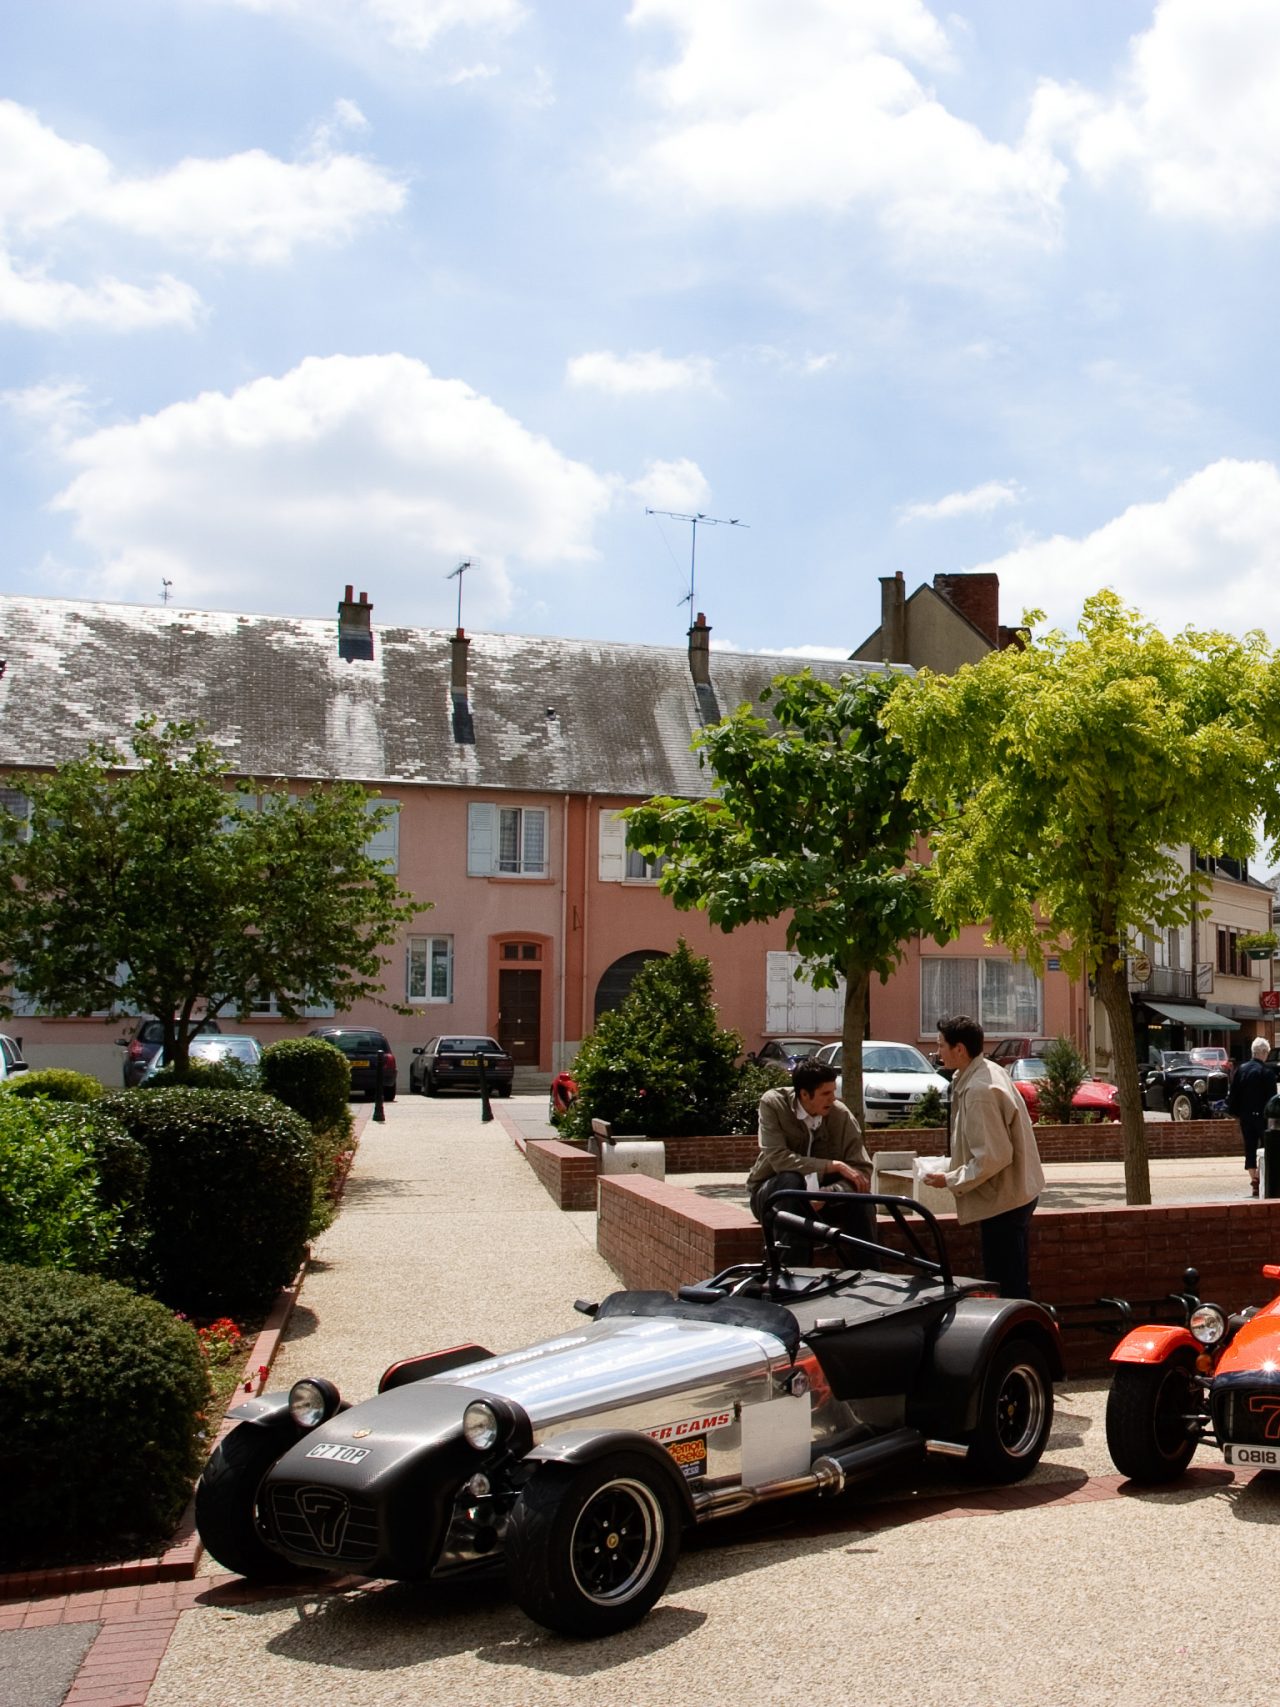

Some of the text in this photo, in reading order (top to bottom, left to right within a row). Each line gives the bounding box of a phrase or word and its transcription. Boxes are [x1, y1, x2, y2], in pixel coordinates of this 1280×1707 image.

[647, 1414, 730, 1440] ER CAMS
[311, 1444, 367, 1462] C7 TOP
[1238, 1449, 1277, 1464] Q818
[302, 1493, 349, 1547] 7
